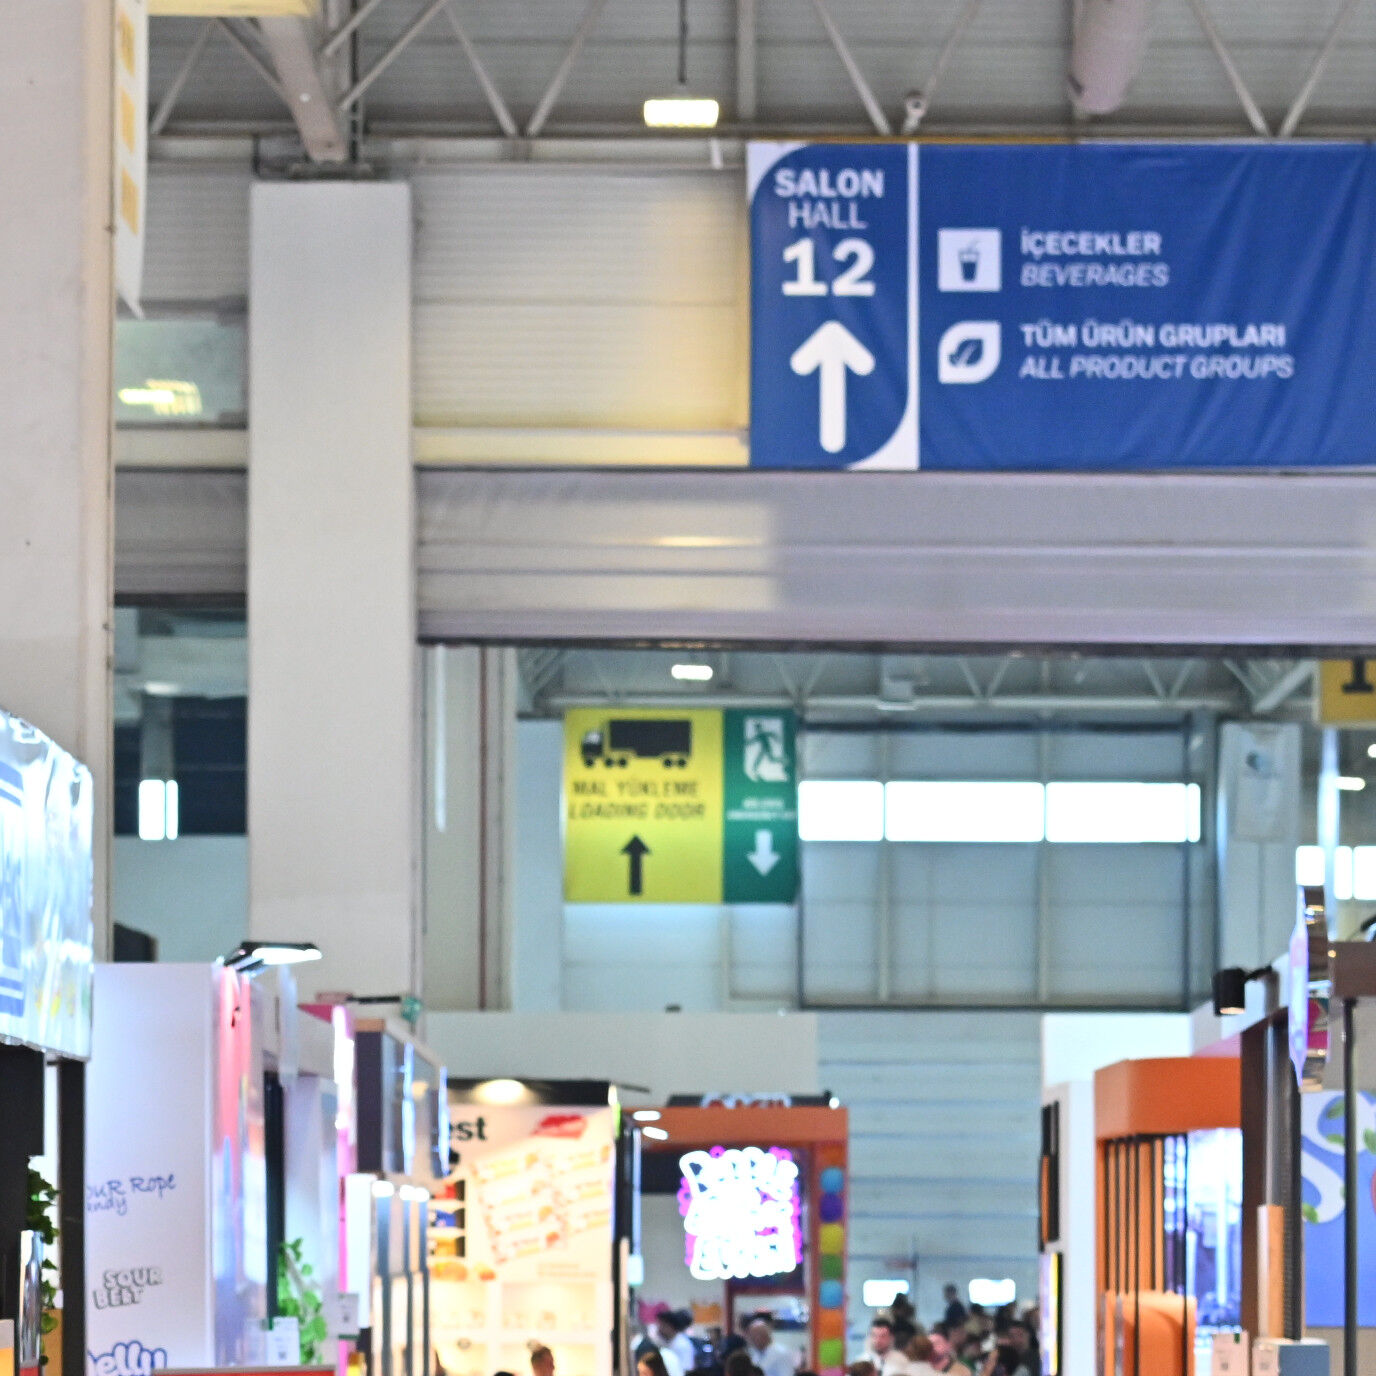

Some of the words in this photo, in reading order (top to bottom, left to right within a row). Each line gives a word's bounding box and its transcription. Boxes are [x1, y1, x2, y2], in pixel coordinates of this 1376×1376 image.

[774, 168, 885, 198] SALON
[788, 201, 868, 229] HALL
[1020, 226, 1162, 260] İÇECEKLER
[781, 237, 876, 296] 12
[1020, 262, 1171, 287] BEVERAGES
[1019, 318, 1078, 348] TÜM
[1081, 318, 1155, 348] ÜRÜN
[1159, 322, 1286, 348] GRUPLARI
[1018, 354, 1064, 379] ALL
[1070, 354, 1187, 379] PRODUCT
[1190, 354, 1295, 379] GROUPS
[574, 780, 608, 797] MAL
